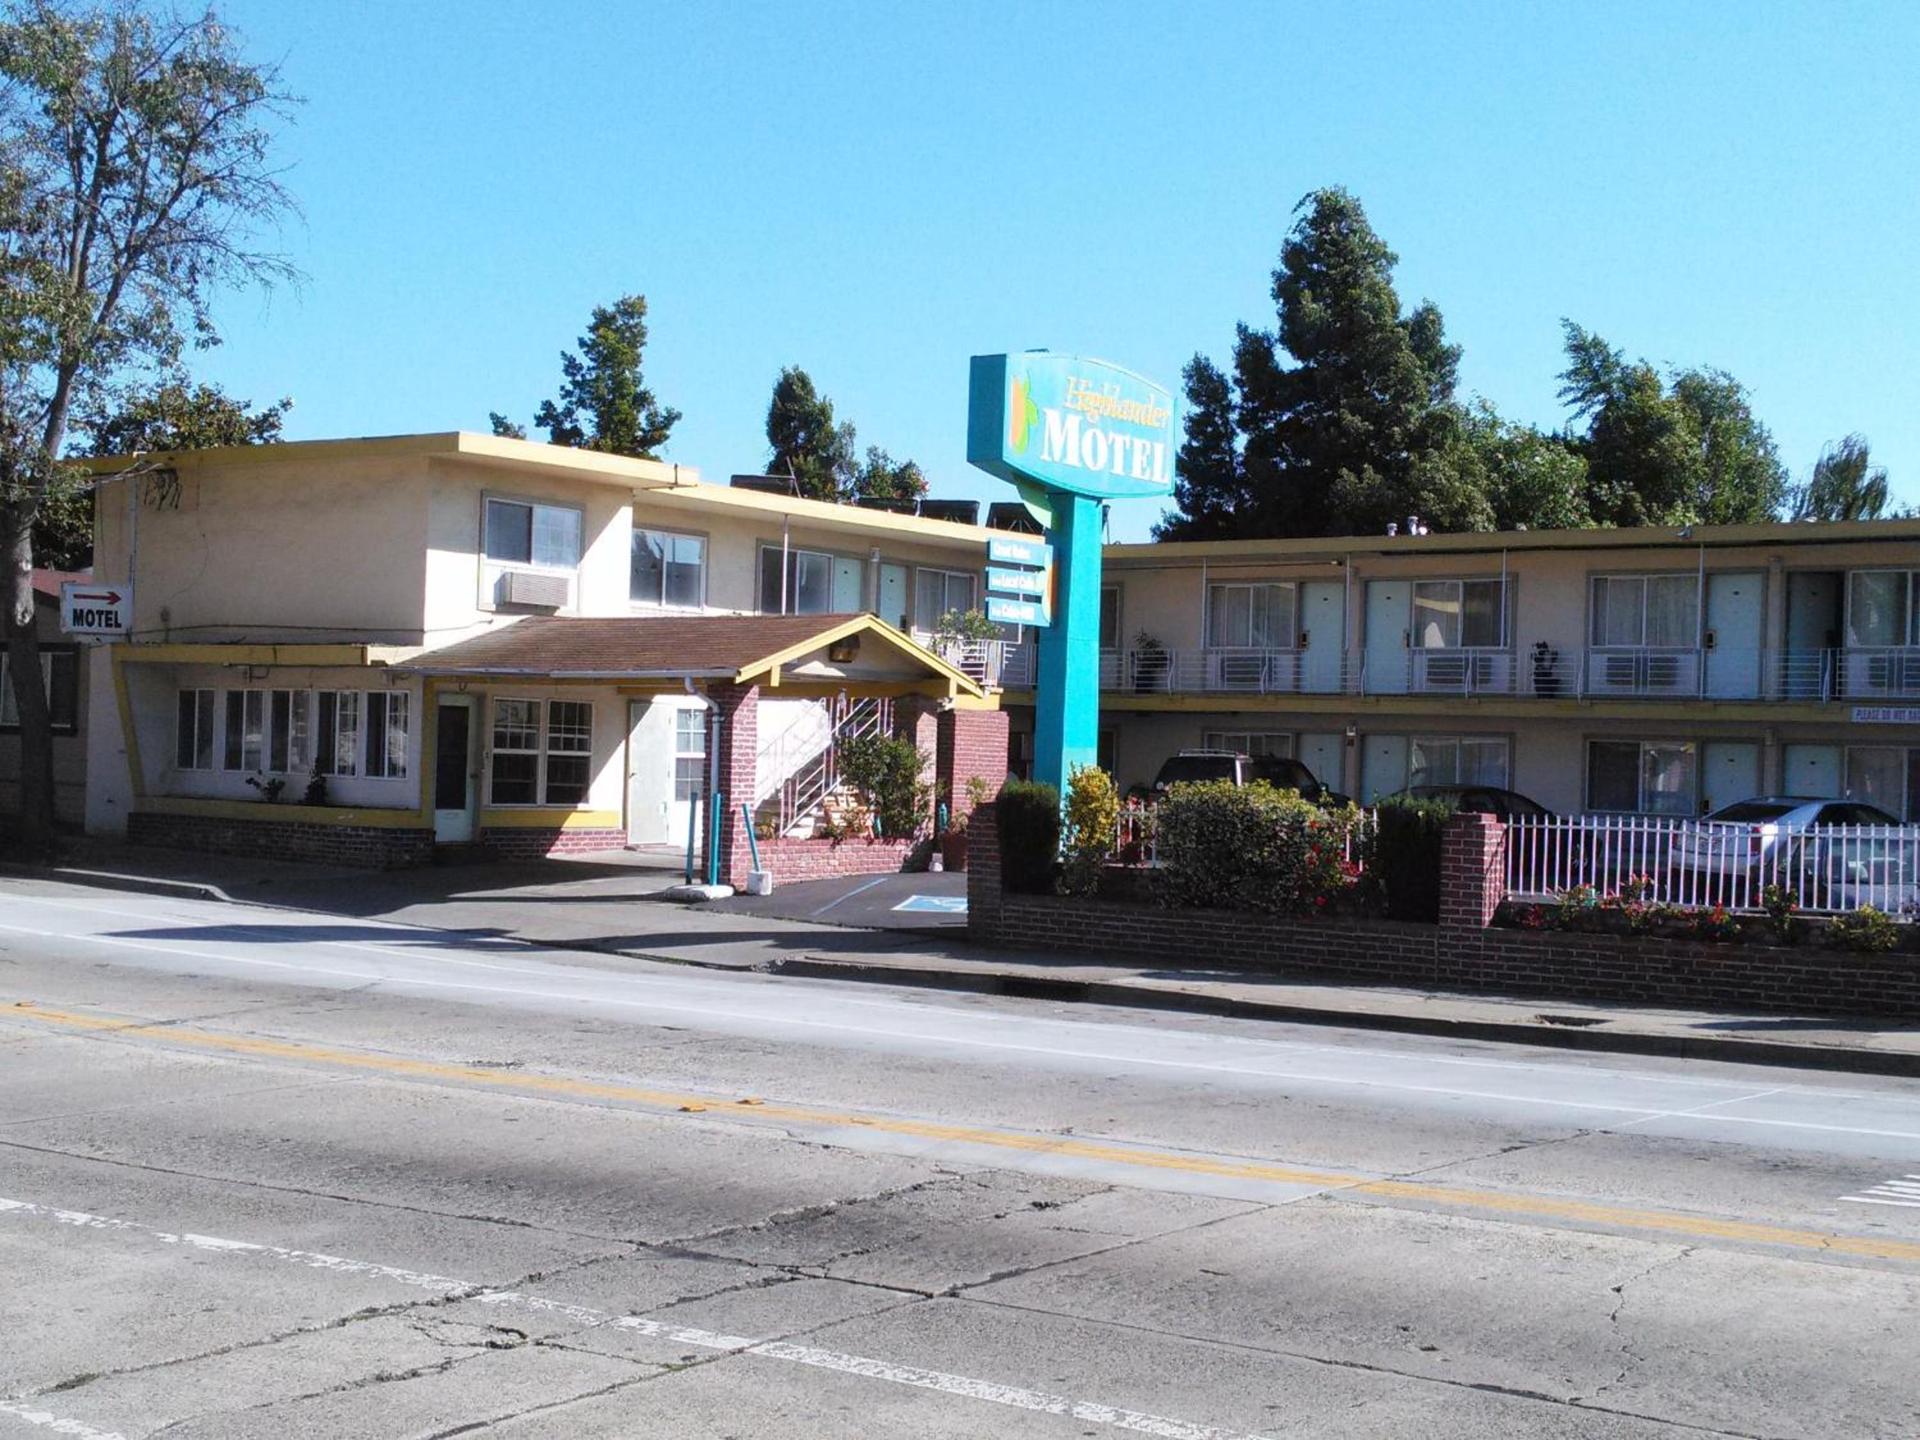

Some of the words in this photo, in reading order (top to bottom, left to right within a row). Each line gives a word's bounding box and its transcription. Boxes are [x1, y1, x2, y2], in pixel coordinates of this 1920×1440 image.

[1063, 376, 1169, 429] Highlander
[1040, 407, 1169, 485] MOTEL
[72, 608, 122, 628] MOTEL
[1856, 709, 1879, 720] PLEASE
